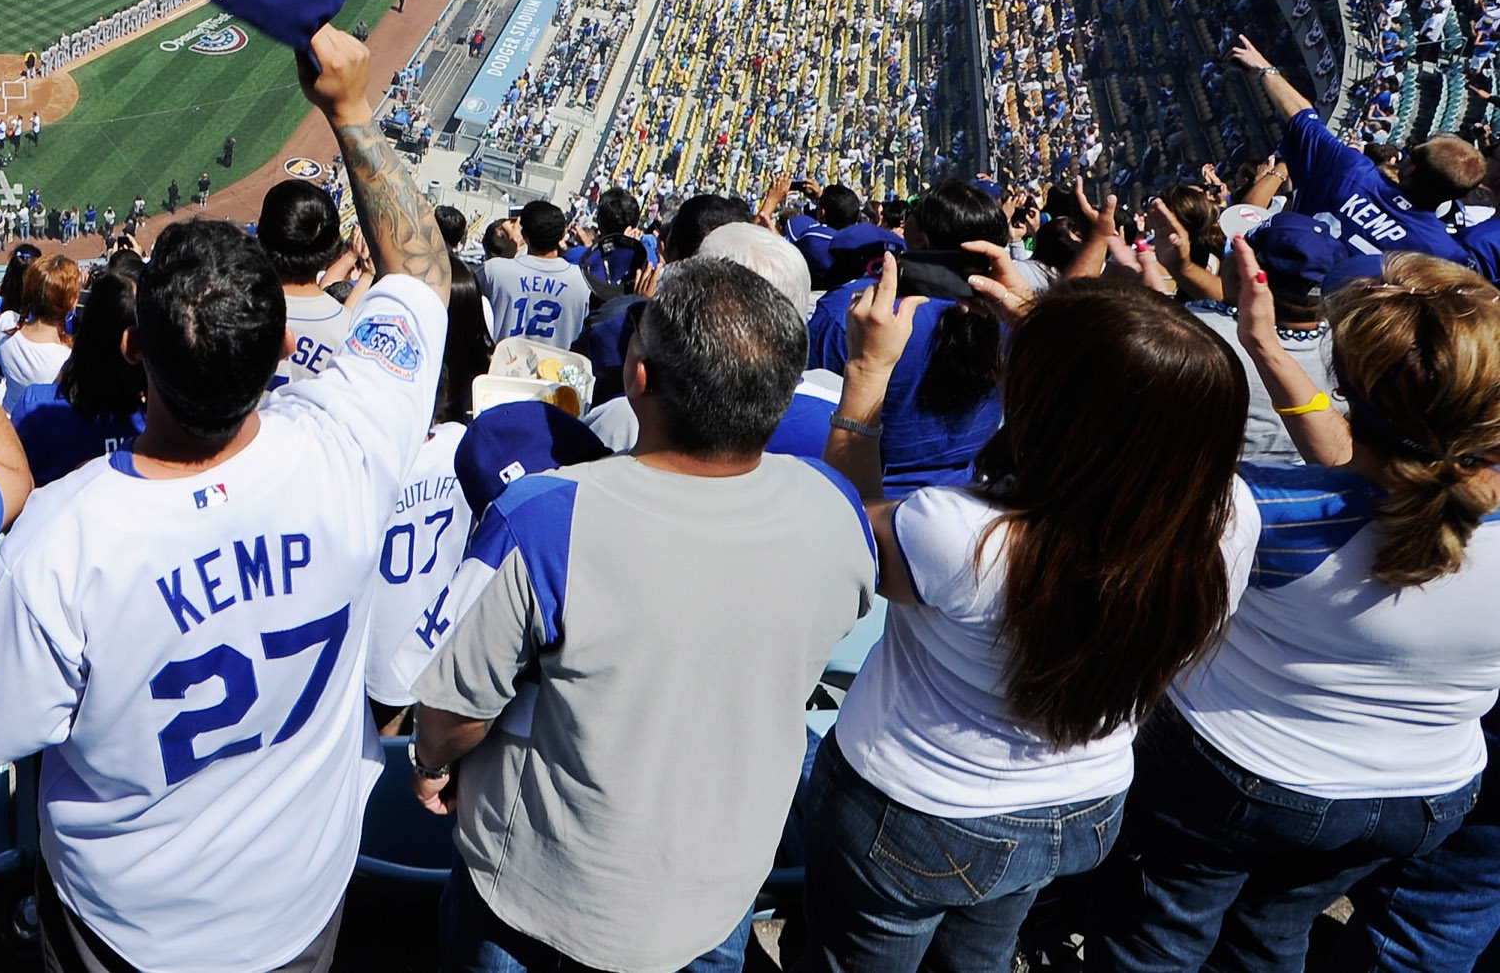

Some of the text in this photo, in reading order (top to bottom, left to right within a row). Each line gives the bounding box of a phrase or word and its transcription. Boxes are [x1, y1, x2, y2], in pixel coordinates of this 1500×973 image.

[160, 12, 234, 52] Opening Week
[487, 34, 522, 77] DODGER
[1339, 193, 1407, 241] KEMP
[520, 276, 568, 297] KENT
[509, 297, 562, 338] 12
[379, 506, 454, 585] 07
[155, 533, 311, 635] KEMP
[149, 601, 351, 787] 27
